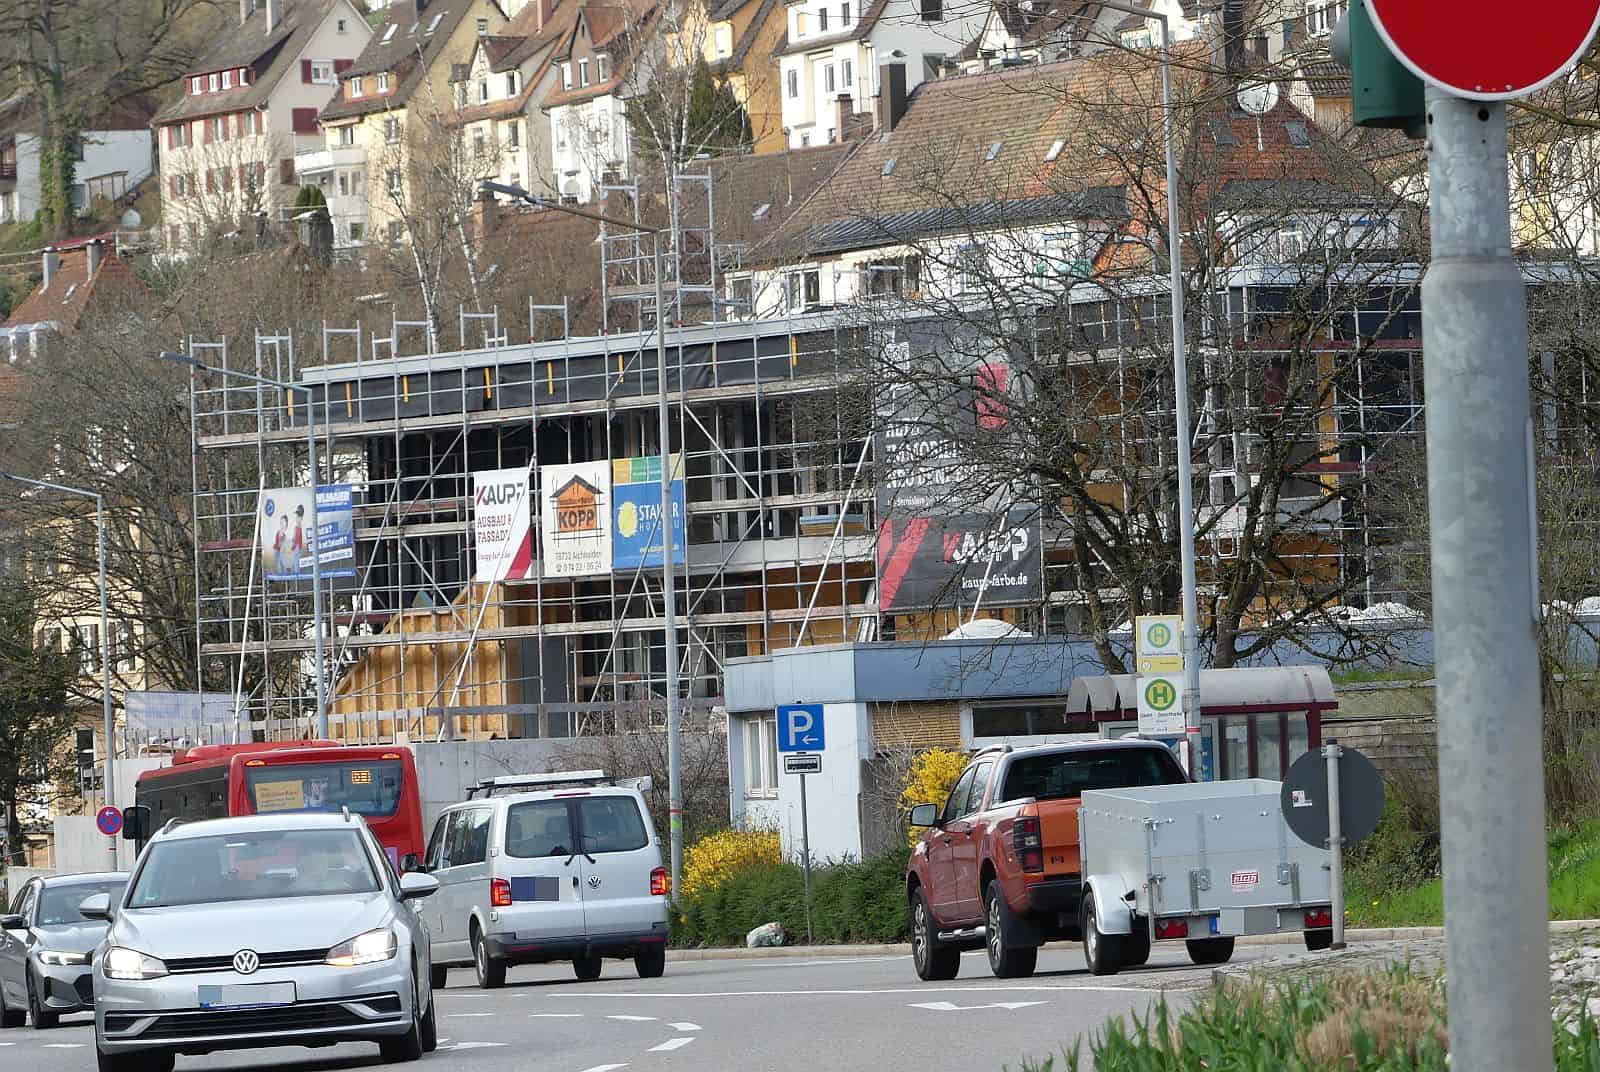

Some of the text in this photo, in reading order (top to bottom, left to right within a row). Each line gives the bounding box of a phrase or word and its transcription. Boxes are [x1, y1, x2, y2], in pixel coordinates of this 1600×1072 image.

[559, 509, 595, 528] KOPP
[1153, 686, 1168, 704] H
[788, 710, 814, 746] P
